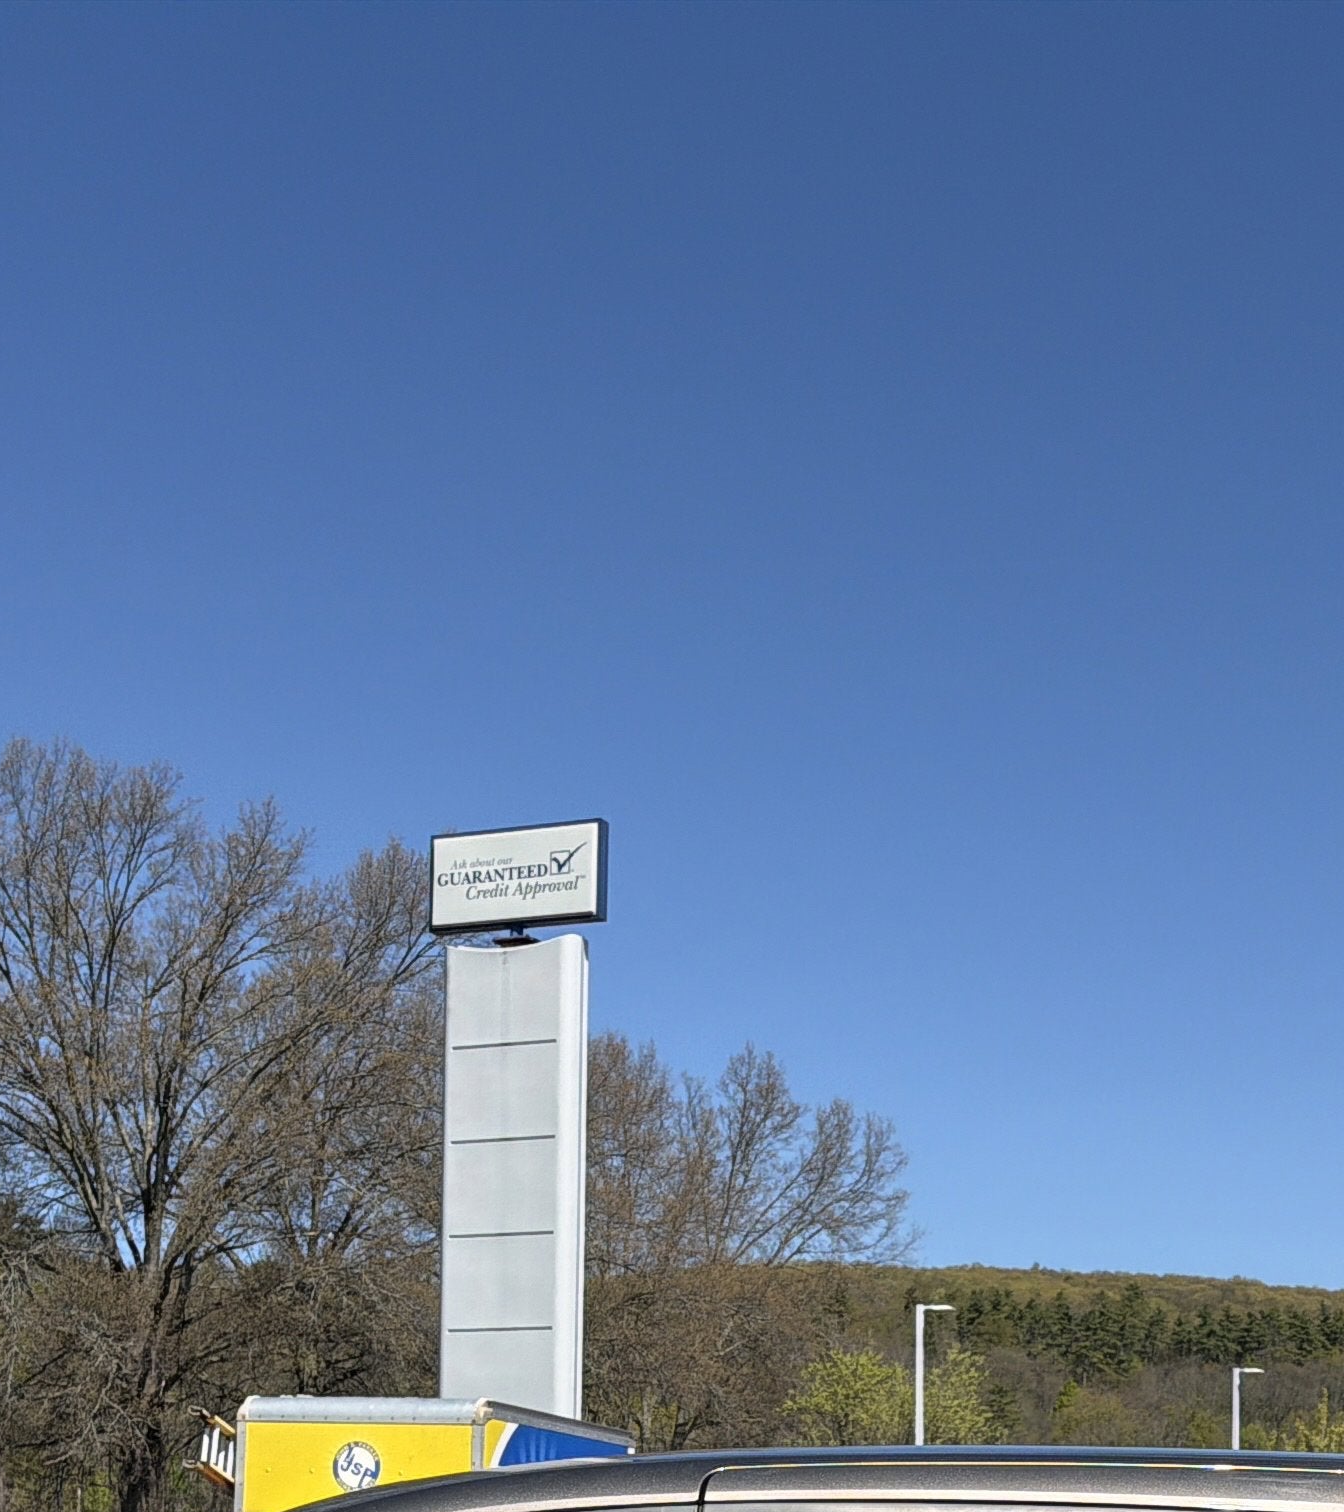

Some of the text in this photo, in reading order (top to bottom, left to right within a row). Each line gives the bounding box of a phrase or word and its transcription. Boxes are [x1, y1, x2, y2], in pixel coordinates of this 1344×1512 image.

[450, 856, 513, 871] Ask about our
[437, 864, 548, 887] GUARANTEED
[465, 882, 508, 901] Credit
